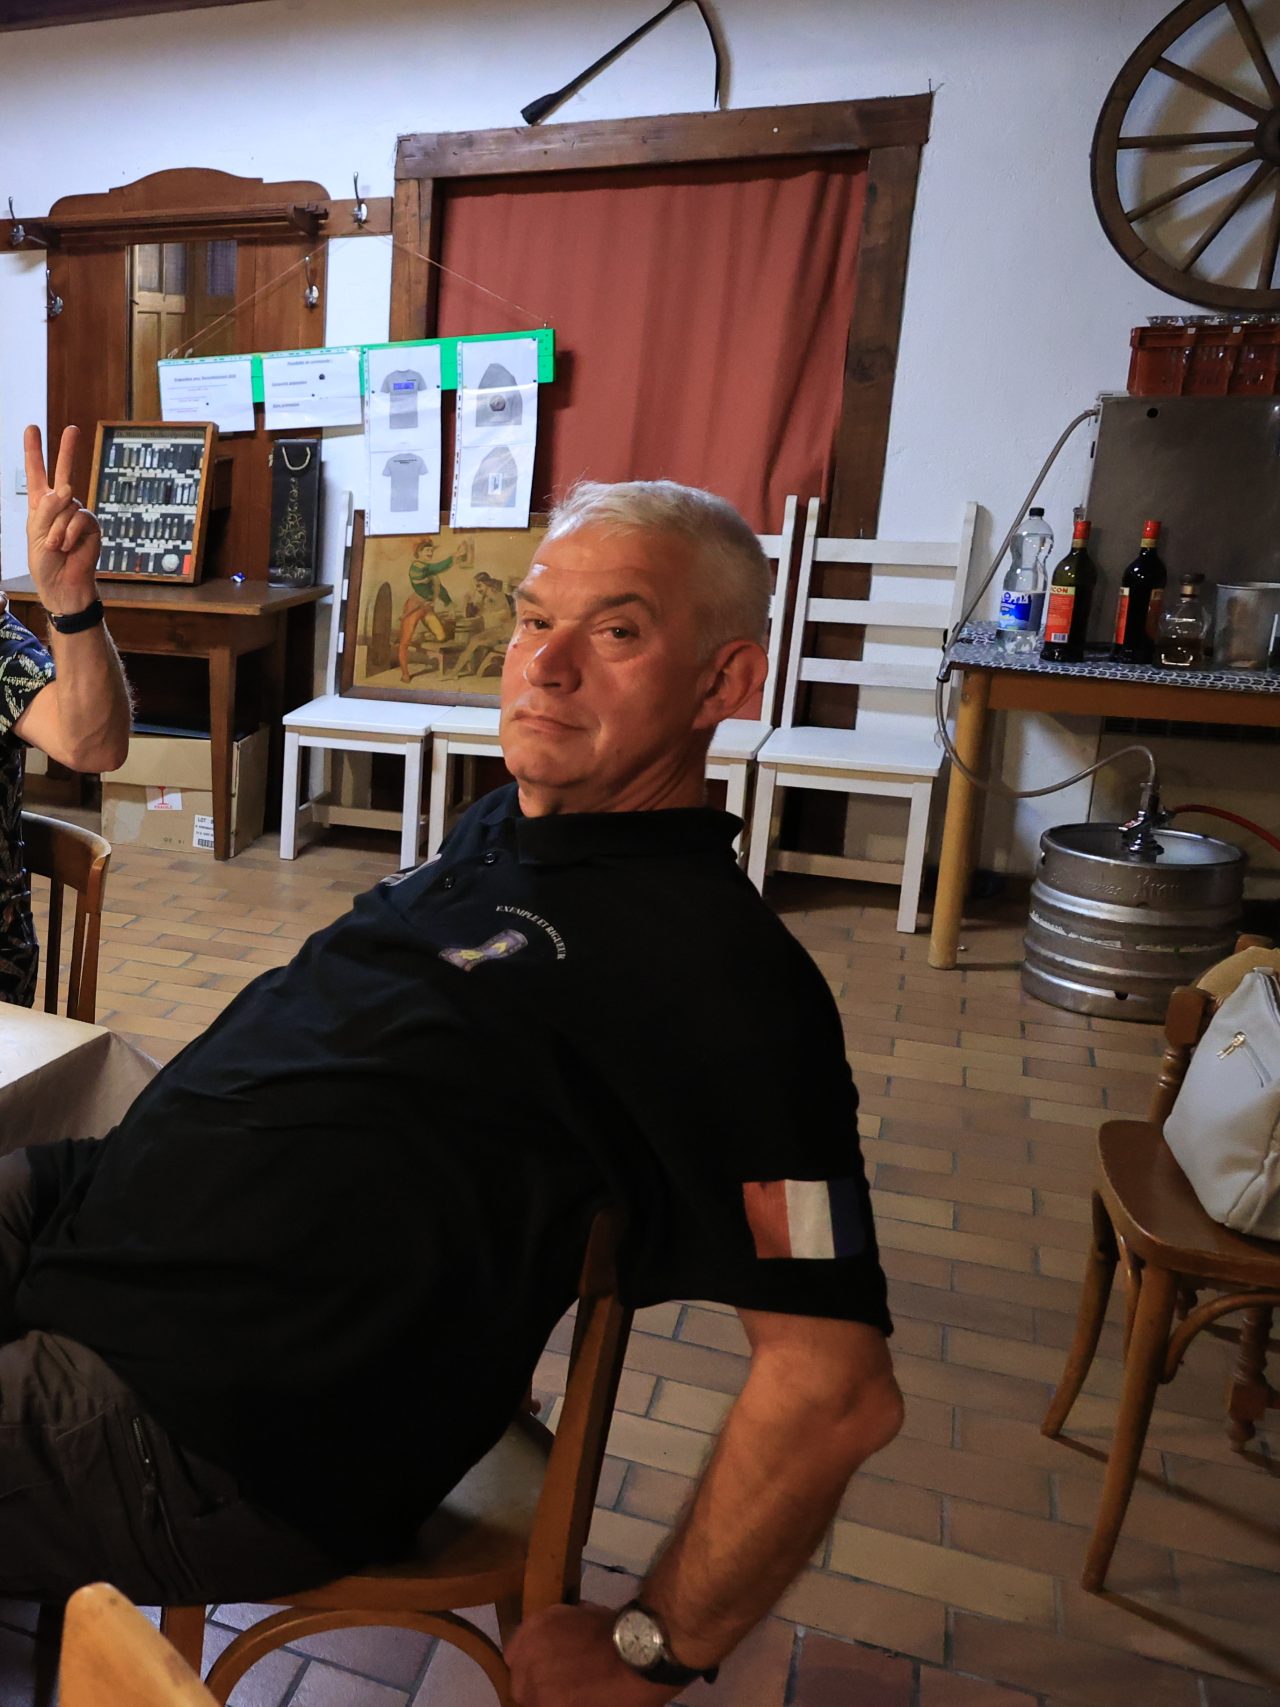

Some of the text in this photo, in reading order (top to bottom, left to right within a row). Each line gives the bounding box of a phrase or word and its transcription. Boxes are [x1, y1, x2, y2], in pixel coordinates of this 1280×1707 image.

[1051, 586, 1069, 594] CON
[495, 904, 538, 922] EXEMPLE
[536, 917, 548, 928] ET
